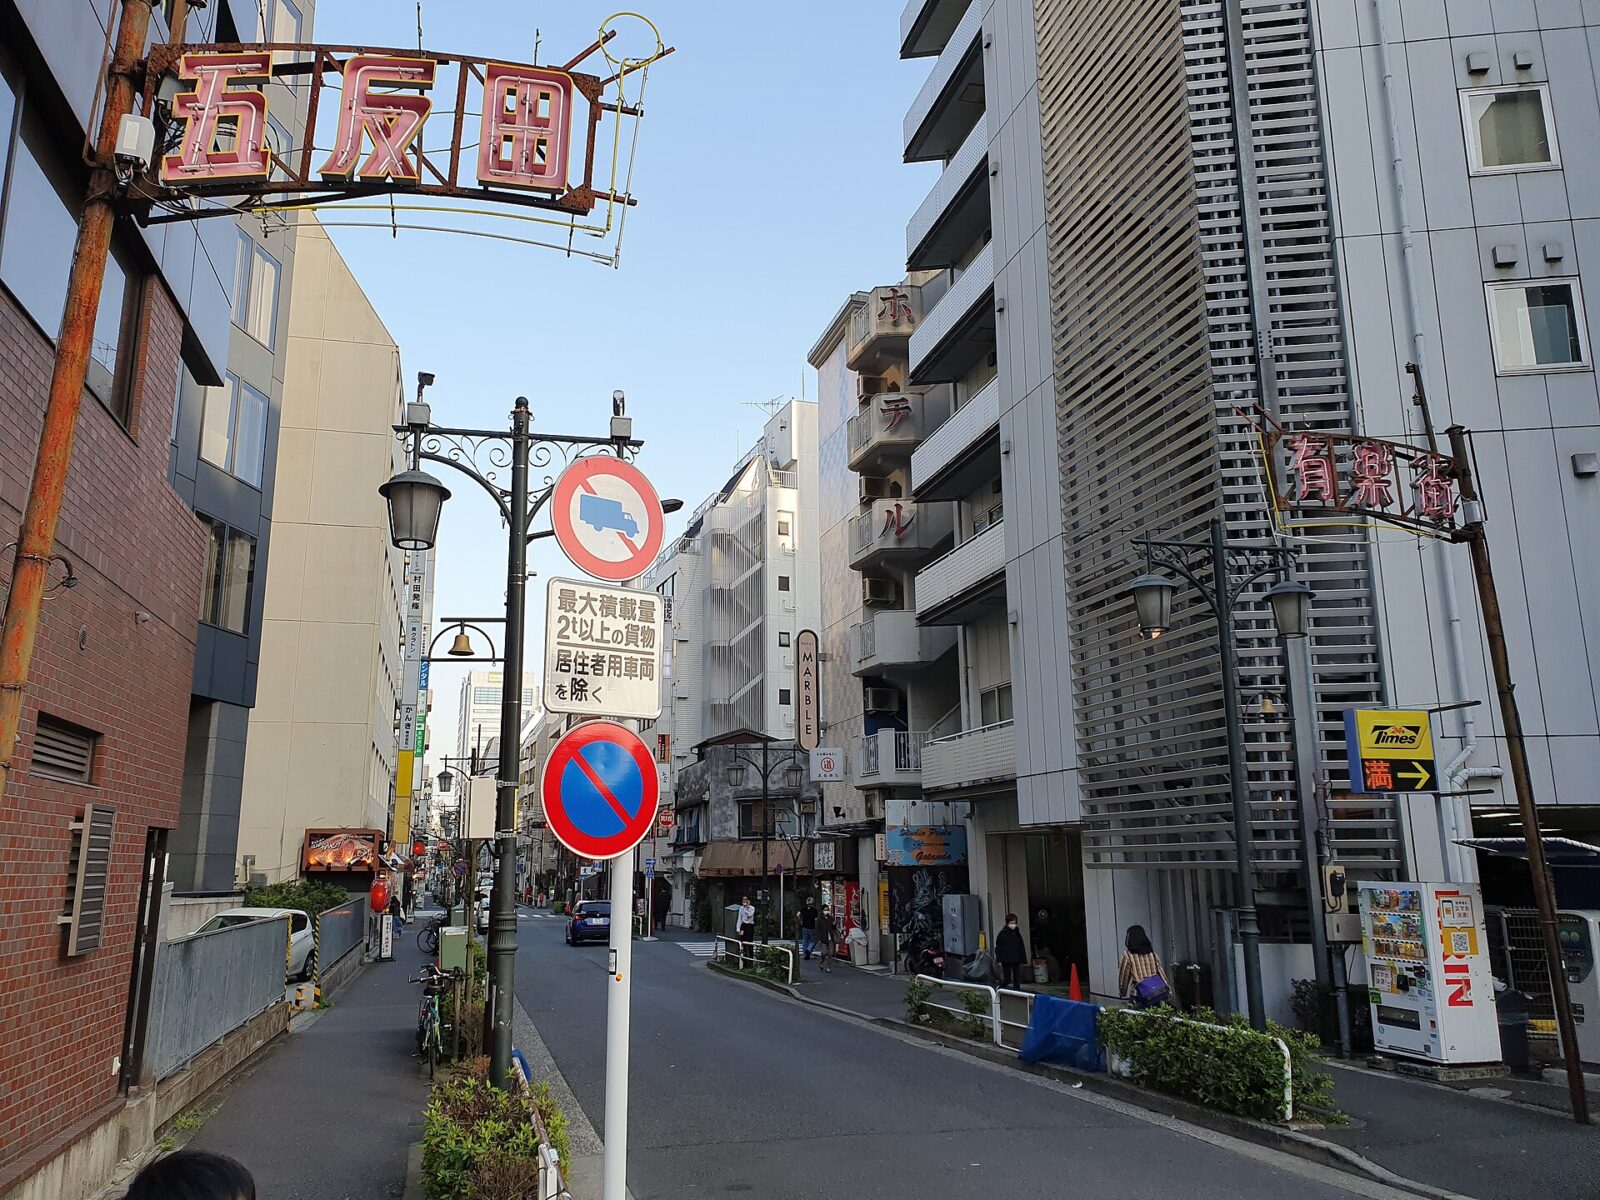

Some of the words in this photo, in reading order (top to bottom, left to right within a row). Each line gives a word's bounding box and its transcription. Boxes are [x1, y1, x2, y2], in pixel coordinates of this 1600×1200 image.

[161, 51, 574, 195] 五反田
[877, 287, 915, 540] ホテル
[557, 588, 656, 624] 最大積載量
[556, 614, 655, 649] 2t以上の貨物
[555, 649, 655, 682] 居住者用車両
[554, 677, 603, 704] を除く
[802, 651, 814, 735] MARBLE
[1371, 725, 1421, 745] Times
[1364, 760, 1393, 790] 満
